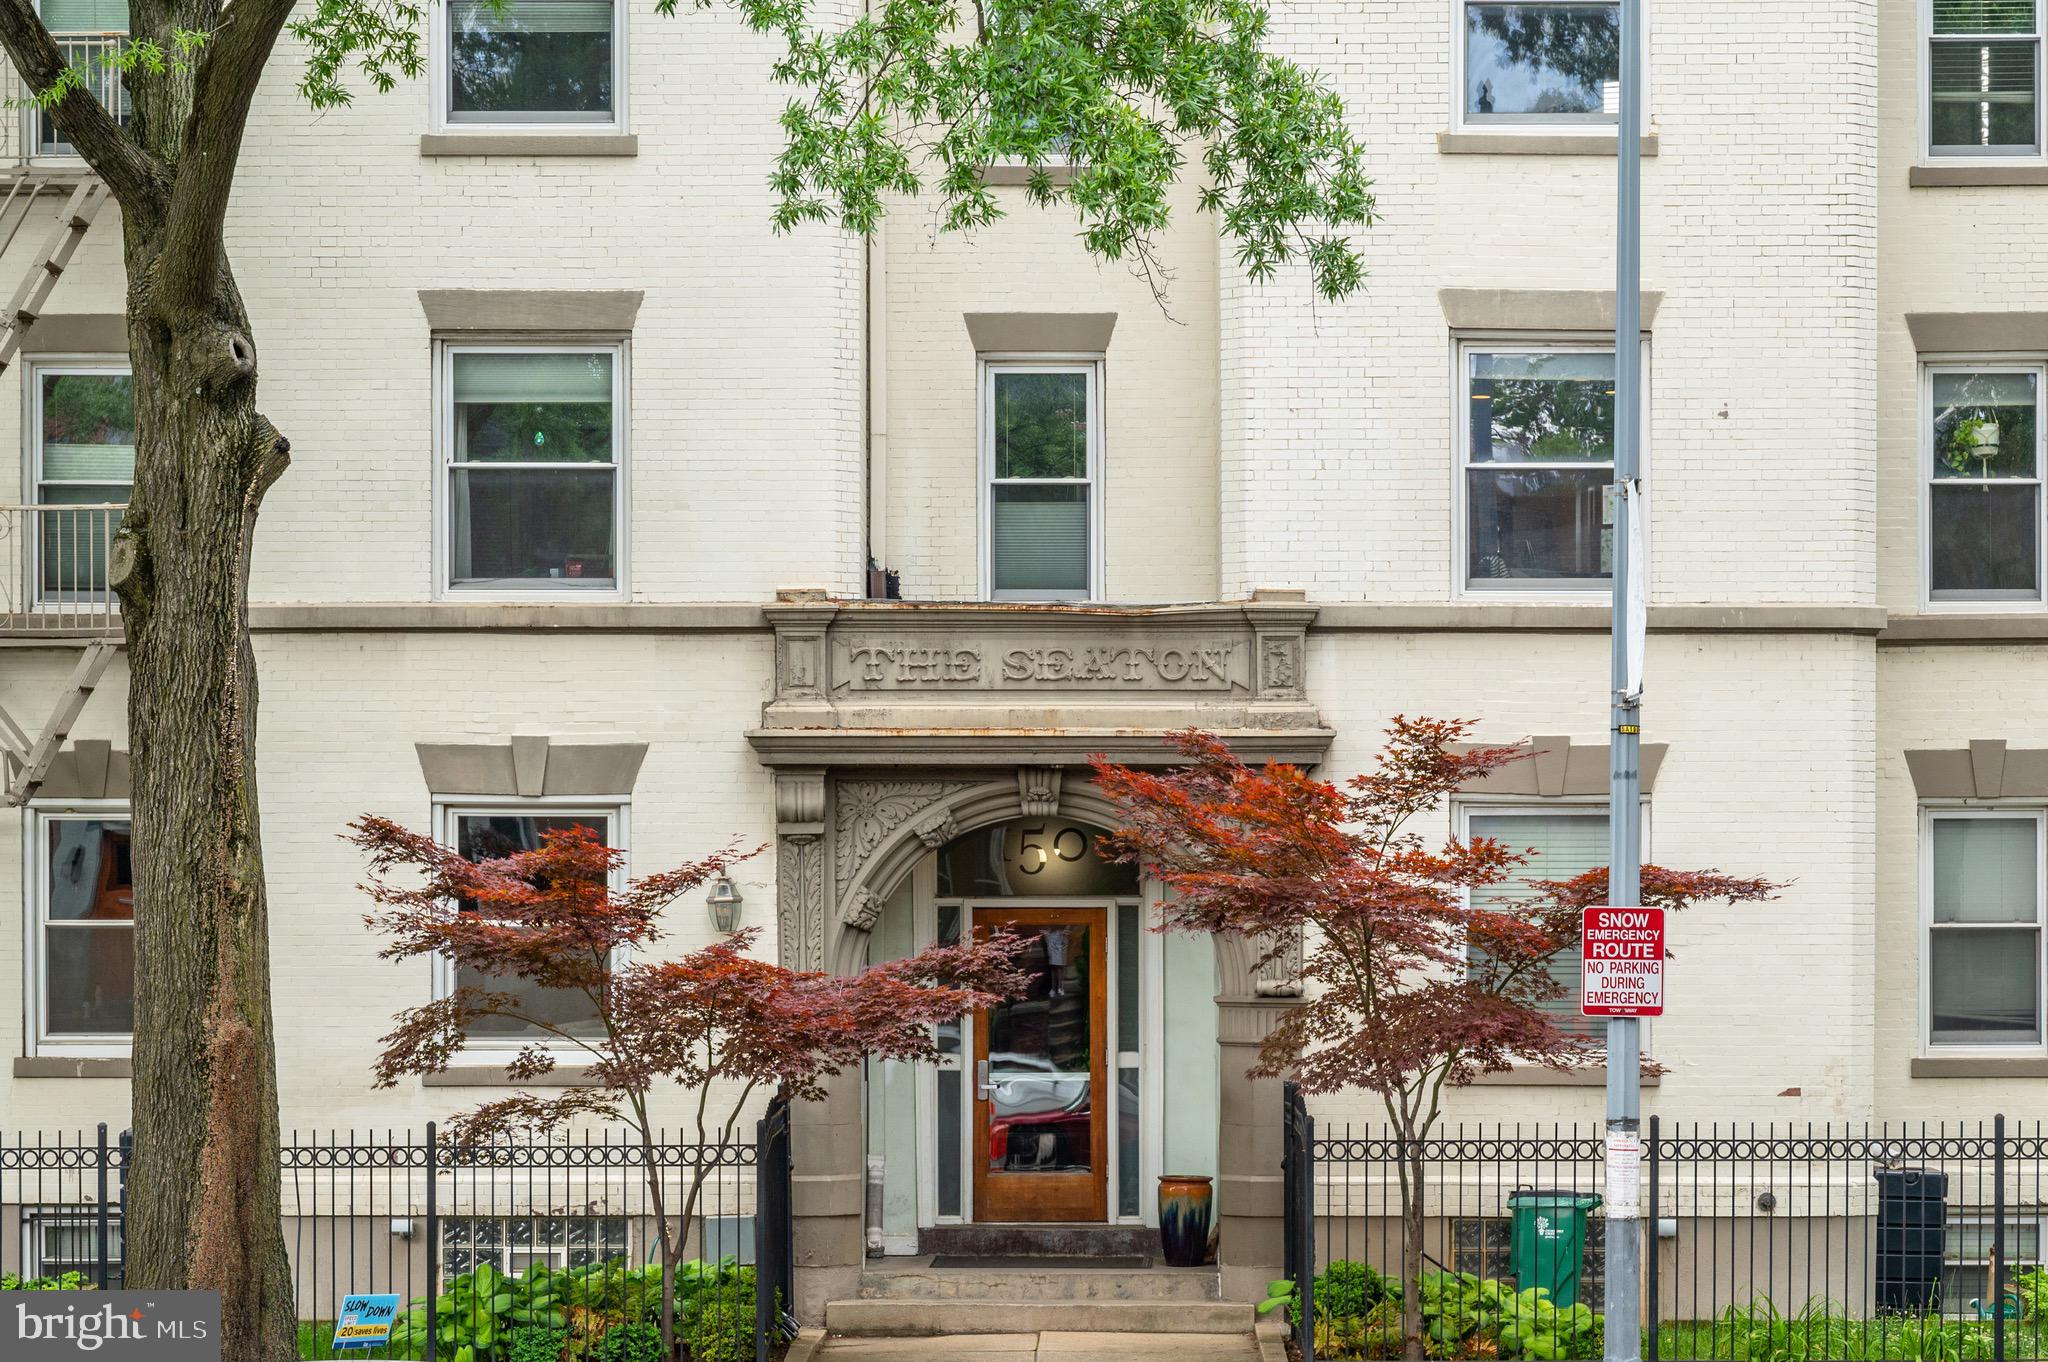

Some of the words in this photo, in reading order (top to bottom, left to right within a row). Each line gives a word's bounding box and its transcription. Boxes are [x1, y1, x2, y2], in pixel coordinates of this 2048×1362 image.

[850, 646, 982, 682] THE
[1001, 646, 1233, 682] SEATON
[1598, 912, 1650, 928] SNOW
[1587, 929, 1660, 941] EMERGENCY
[1592, 942, 1655, 958] ROUTE
[1587, 961, 1604, 974] NO
[1609, 961, 1660, 974] PARKING
[1601, 976, 1645, 989] DURING
[1586, 991, 1659, 1004] EMERGENCY
[345, 1299, 369, 1312] SLOW
[365, 1305, 395, 1318] DOWN
[341, 1326, 354, 1337] 20
[354, 1327, 372, 1336] saves
[373, 1326, 388, 1335] lives
